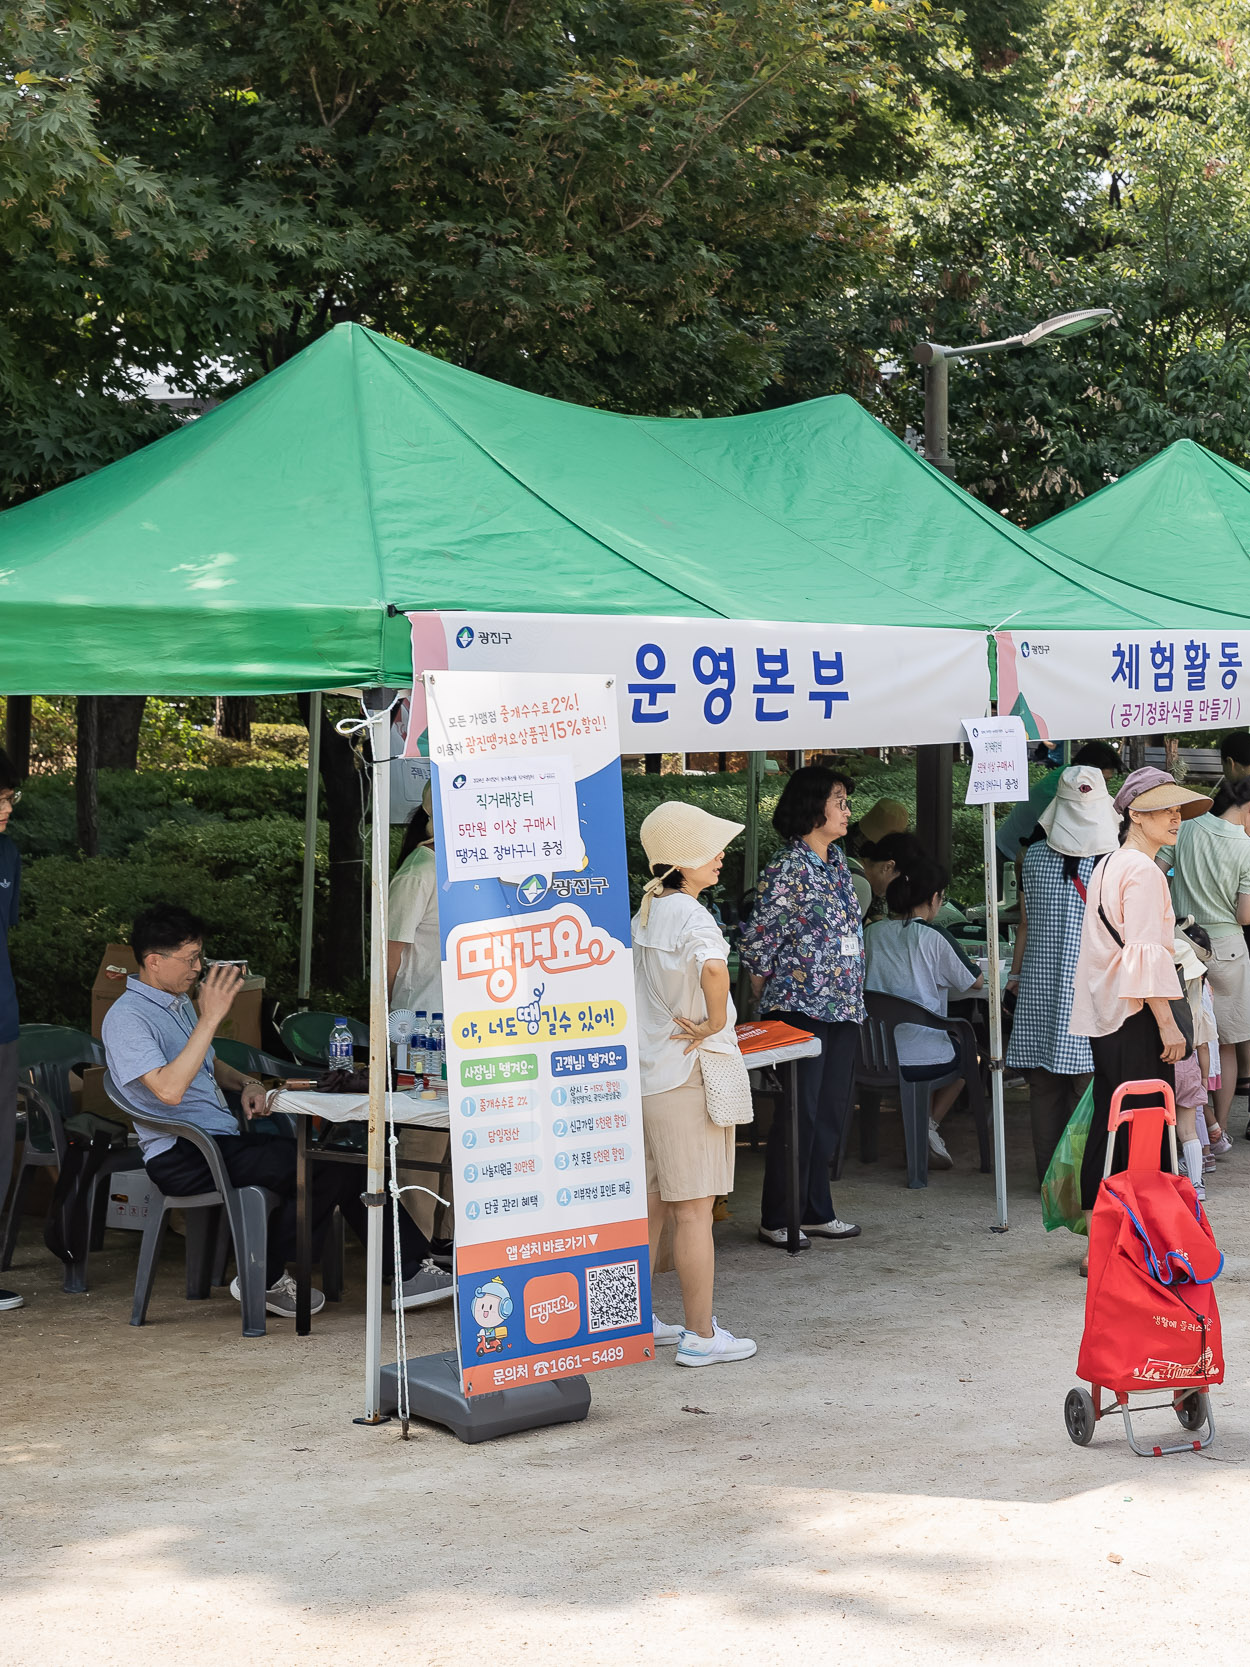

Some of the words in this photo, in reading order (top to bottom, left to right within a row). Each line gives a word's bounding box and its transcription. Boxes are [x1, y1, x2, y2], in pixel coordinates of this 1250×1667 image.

[478, 630, 513, 646] 광진구
[1031, 645, 1050, 656] 광진구
[1111, 638, 1243, 693] 체험활동
[626, 642, 851, 725] 운영본부
[448, 715, 468, 729] 모든
[469, 710, 497, 726] 가맹점
[436, 741, 464, 757] 이용자
[1004, 778, 1019, 790] 증정
[476, 790, 534, 811] 직거래장터
[458, 821, 487, 839] 5만원
[493, 819, 517, 836] 이상
[522, 815, 556, 833] 구매시
[456, 846, 489, 865] 땡겨요
[493, 842, 536, 861] 장바구니
[541, 840, 563, 857] 증정
[551, 876, 610, 898] 광진구
[456, 914, 616, 1004] 땡겨요
[461, 1021, 482, 1044] 야,
[578, 1005, 615, 1033] 있어!
[464, 1063, 496, 1081] 사장님!
[555, 1054, 585, 1072] 고객님!
[570, 1085, 582, 1097] 상시
[479, 1097, 514, 1112] 중개수수료
[516, 1095, 528, 1107] 2%
[570, 1117, 594, 1133] 신규가입
[595, 1116, 612, 1129] 5천원
[613, 1113, 627, 1127] 할인
[488, 1127, 520, 1144] 당일정산
[571, 1153, 579, 1166] 첫
[580, 1151, 592, 1165] 주문
[593, 1149, 611, 1163] 5천원
[611, 1147, 625, 1161] 할인
[482, 1161, 512, 1178] 나눔지원금
[513, 1159, 536, 1174] 30만원
[573, 1186, 599, 1200] 리뷰작성
[600, 1183, 617, 1197] 포인트
[618, 1181, 631, 1195] 제공
[484, 1199, 499, 1215] 단골
[501, 1197, 519, 1212] 관리
[521, 1195, 539, 1208] 혜택
[506, 1245, 519, 1262] 앱
[518, 1241, 542, 1259] 설치
[543, 1233, 587, 1255] 바로가기
[529, 1295, 578, 1325] 땡겨요
[493, 1363, 529, 1386] 문의처
[550, 1346, 624, 1374] 1661-5489
